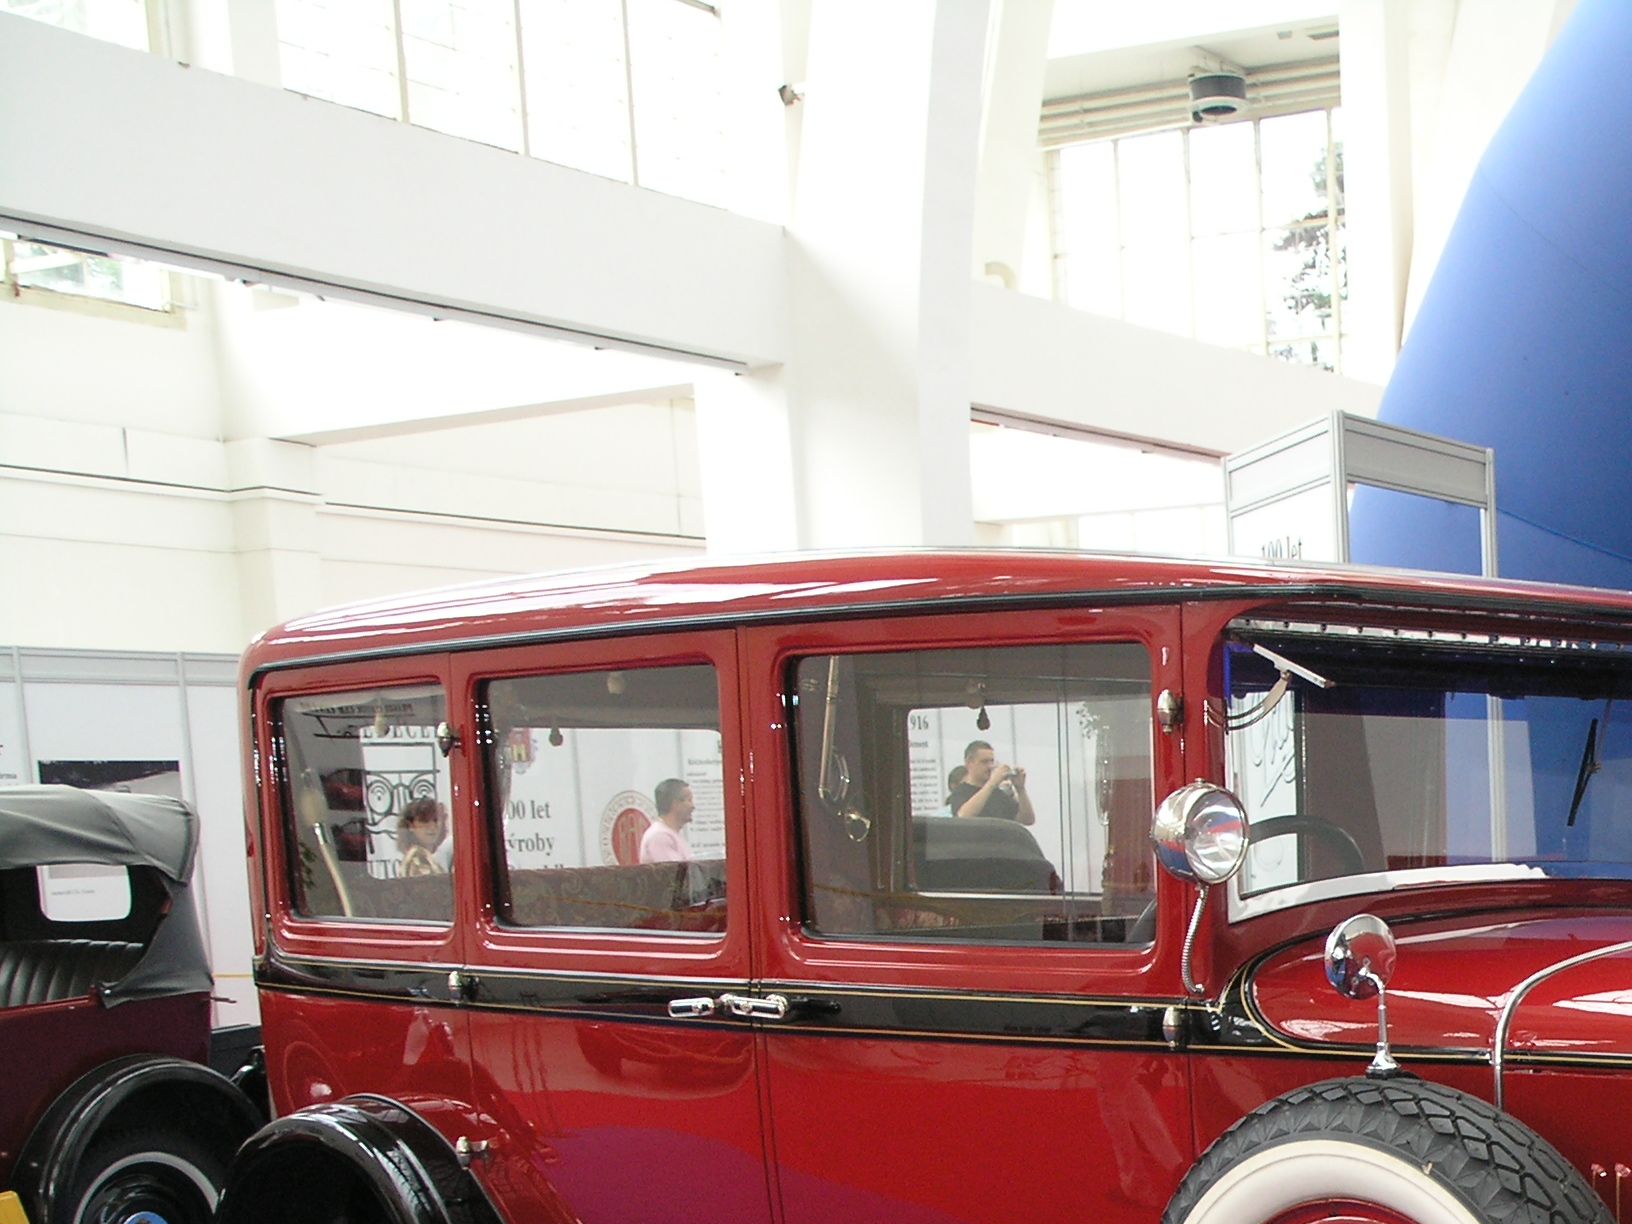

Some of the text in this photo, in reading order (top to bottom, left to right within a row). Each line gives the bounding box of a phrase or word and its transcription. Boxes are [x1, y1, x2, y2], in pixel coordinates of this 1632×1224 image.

[909, 715, 929, 730] 916
[507, 799, 551, 819] 00 let
[508, 832, 555, 857] ýroby
